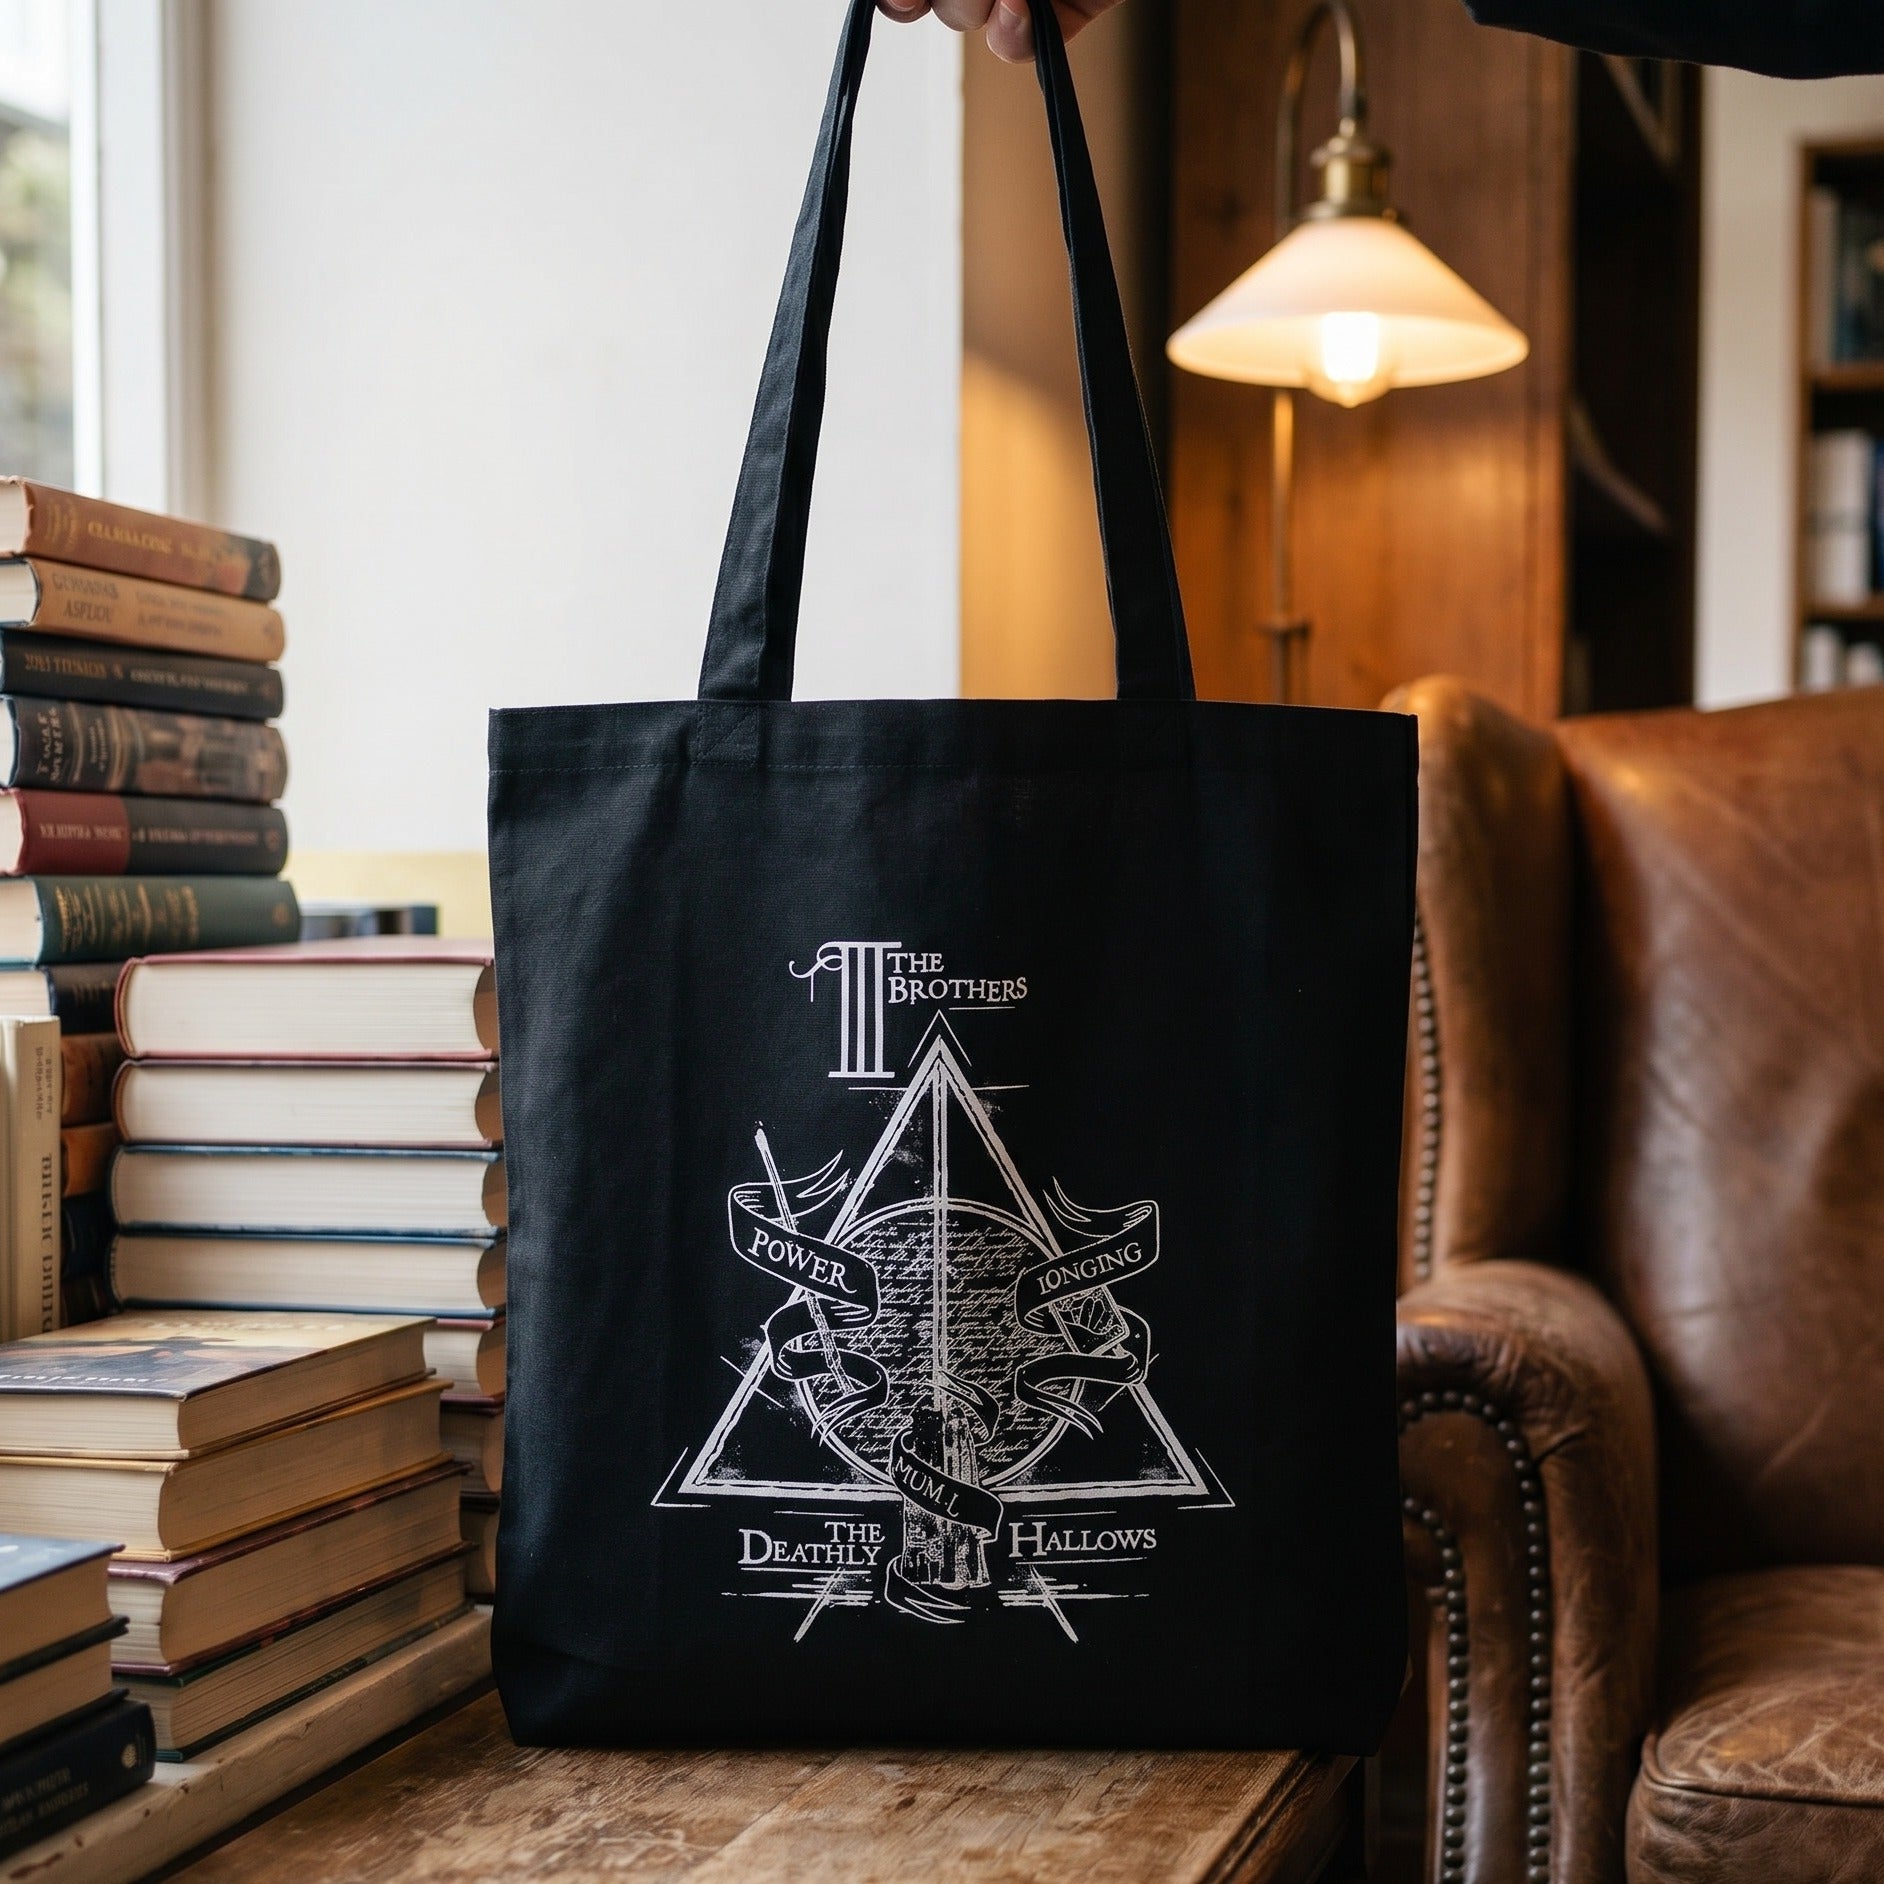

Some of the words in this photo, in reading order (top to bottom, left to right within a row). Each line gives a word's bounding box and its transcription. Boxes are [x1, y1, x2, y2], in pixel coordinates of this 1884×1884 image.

[886, 952, 944, 974] THE
[887, 976, 1029, 1005] BROTHERS
[747, 1226, 858, 1294] POWER
[737, 1528, 882, 1566] DEATHLY
[1008, 1521, 1158, 1558] HALLOWS
[824, 1521, 886, 1543] THE
